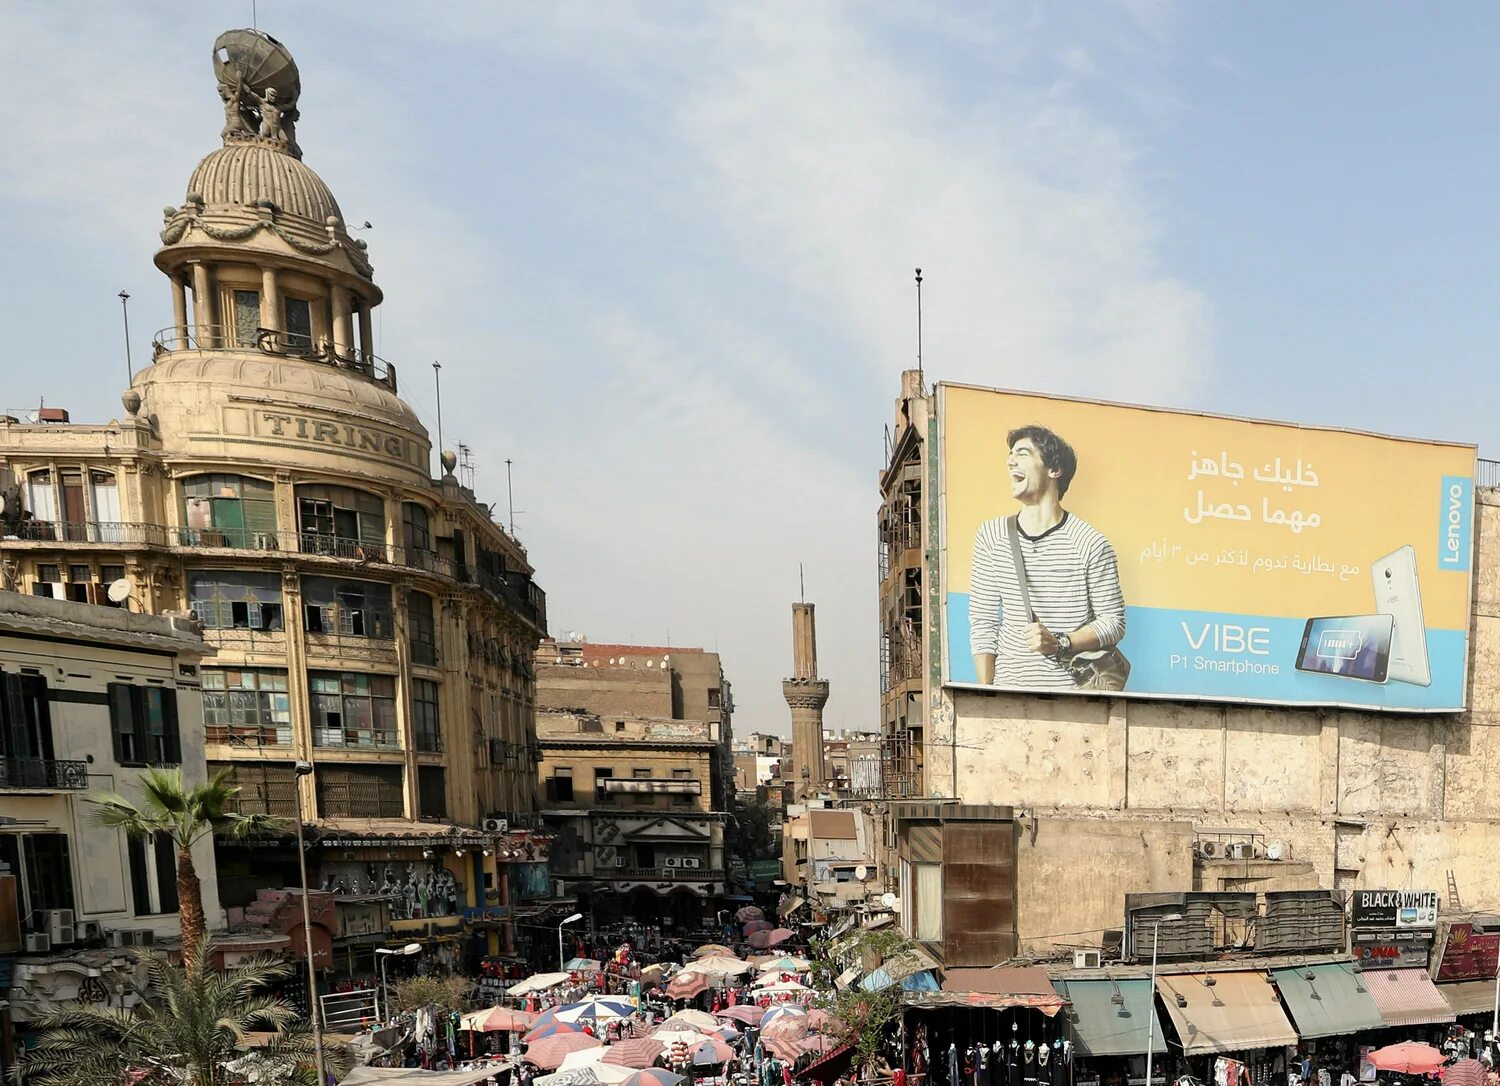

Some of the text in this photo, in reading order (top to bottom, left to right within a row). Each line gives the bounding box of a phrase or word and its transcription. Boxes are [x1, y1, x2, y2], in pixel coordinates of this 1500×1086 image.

[263, 413, 402, 457] TIRING
[1187, 450, 1319, 492] خليك جاهز
[1184, 489, 1321, 534] مهما حصل
[1443, 484, 1463, 563] Lenovo
[1139, 537, 1168, 564] أيام
[1172, 545, 1182, 559] ٣
[1185, 550, 1209, 566] من
[1253, 555, 1288, 573] تدوم
[1292, 555, 1335, 576] بطارية
[1339, 564, 1360, 581] مع
[1181, 621, 1270, 655] VIBE
[1170, 655, 1280, 676] P1 Smartphone
